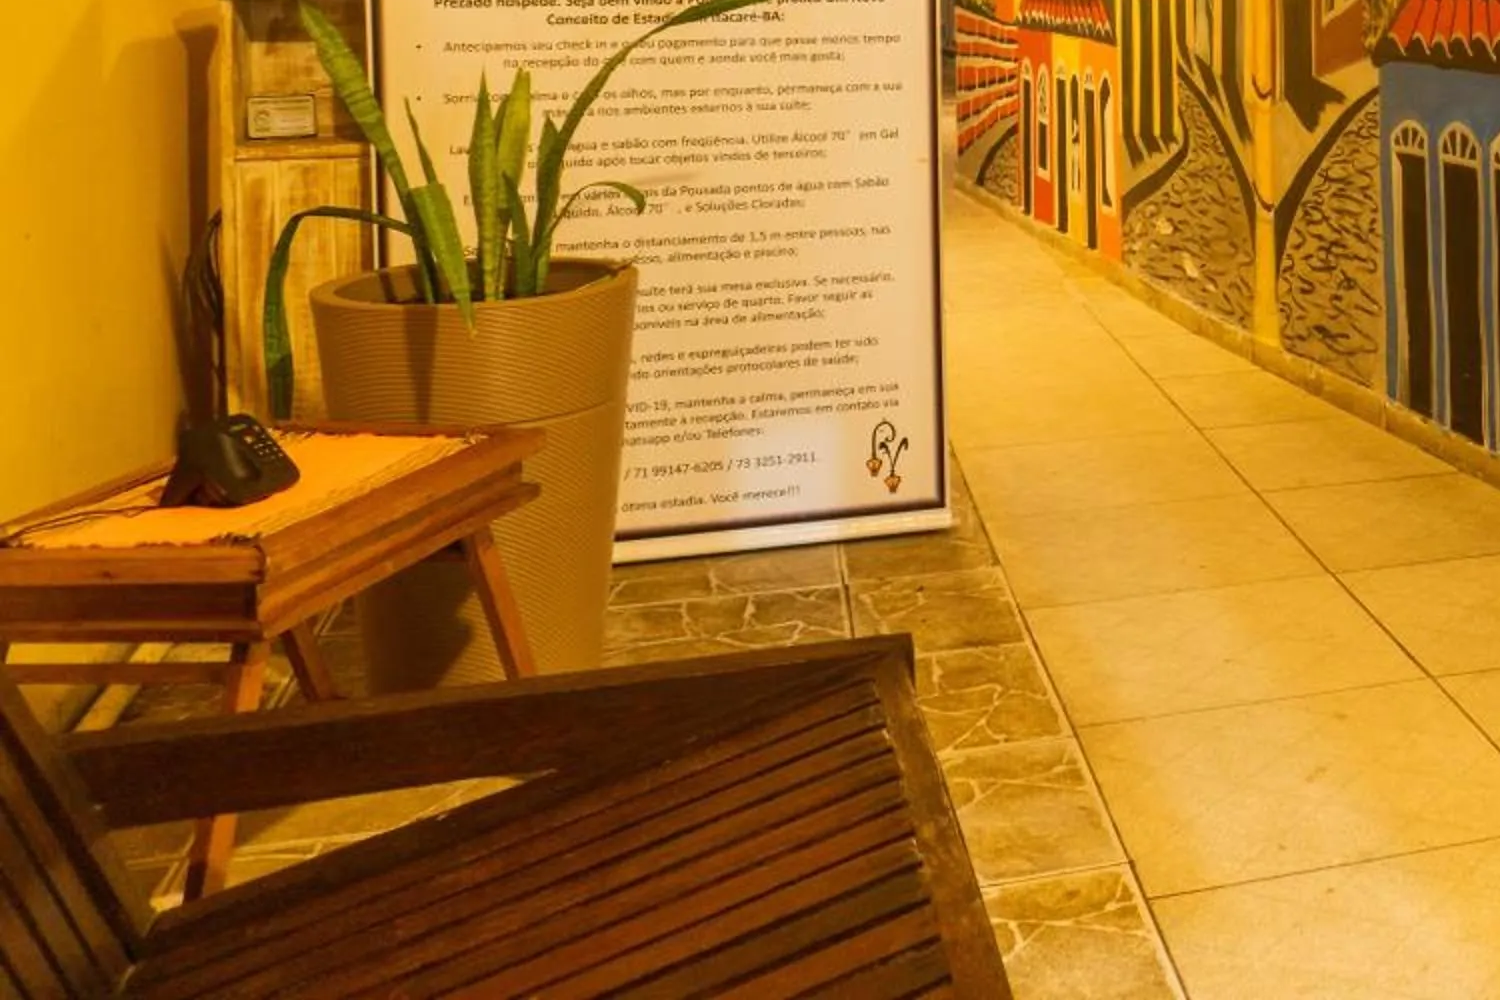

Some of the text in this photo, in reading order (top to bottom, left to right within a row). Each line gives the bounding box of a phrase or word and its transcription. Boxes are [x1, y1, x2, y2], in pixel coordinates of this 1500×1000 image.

[546, 13, 608, 26] Conceito
[611, 12, 629, 25] de
[556, 38, 591, 51] check
[730, 38, 756, 49] para
[760, 38, 783, 49] que
[863, 34, 901, 47] tempo
[522, 56, 580, 70] recepção
[660, 55, 694, 67] quem
[749, 50, 777, 62] você
[689, 86, 709, 98] por
[612, 137, 649, 150] sabão
[652, 138, 677, 148] com
[753, 149, 769, 161] de
[680, 184, 731, 197] Pousada
[733, 182, 775, 196] pontos
[777, 180, 793, 192] de
[855, 176, 889, 188] Sabão
[695, 200, 748, 214] Soluções
[556, 238, 619, 252] mantenha
[633, 233, 727, 249] distanciamento
[730, 232, 745, 244] de
[668, 248, 741, 263] alimentação
[813, 275, 828, 287] Se
[724, 297, 739, 309] de
[732, 314, 747, 325] de
[653, 363, 723, 379] orientações
[726, 357, 800, 374] protocolares
[803, 356, 819, 367] de
[675, 396, 735, 410] mantenha
[789, 385, 855, 401] permaneça
[858, 384, 877, 395] em
[624, 416, 677, 430] tamente
[815, 403, 833, 413] em
[634, 466, 648, 480] 71
[709, 489, 740, 504] Você
